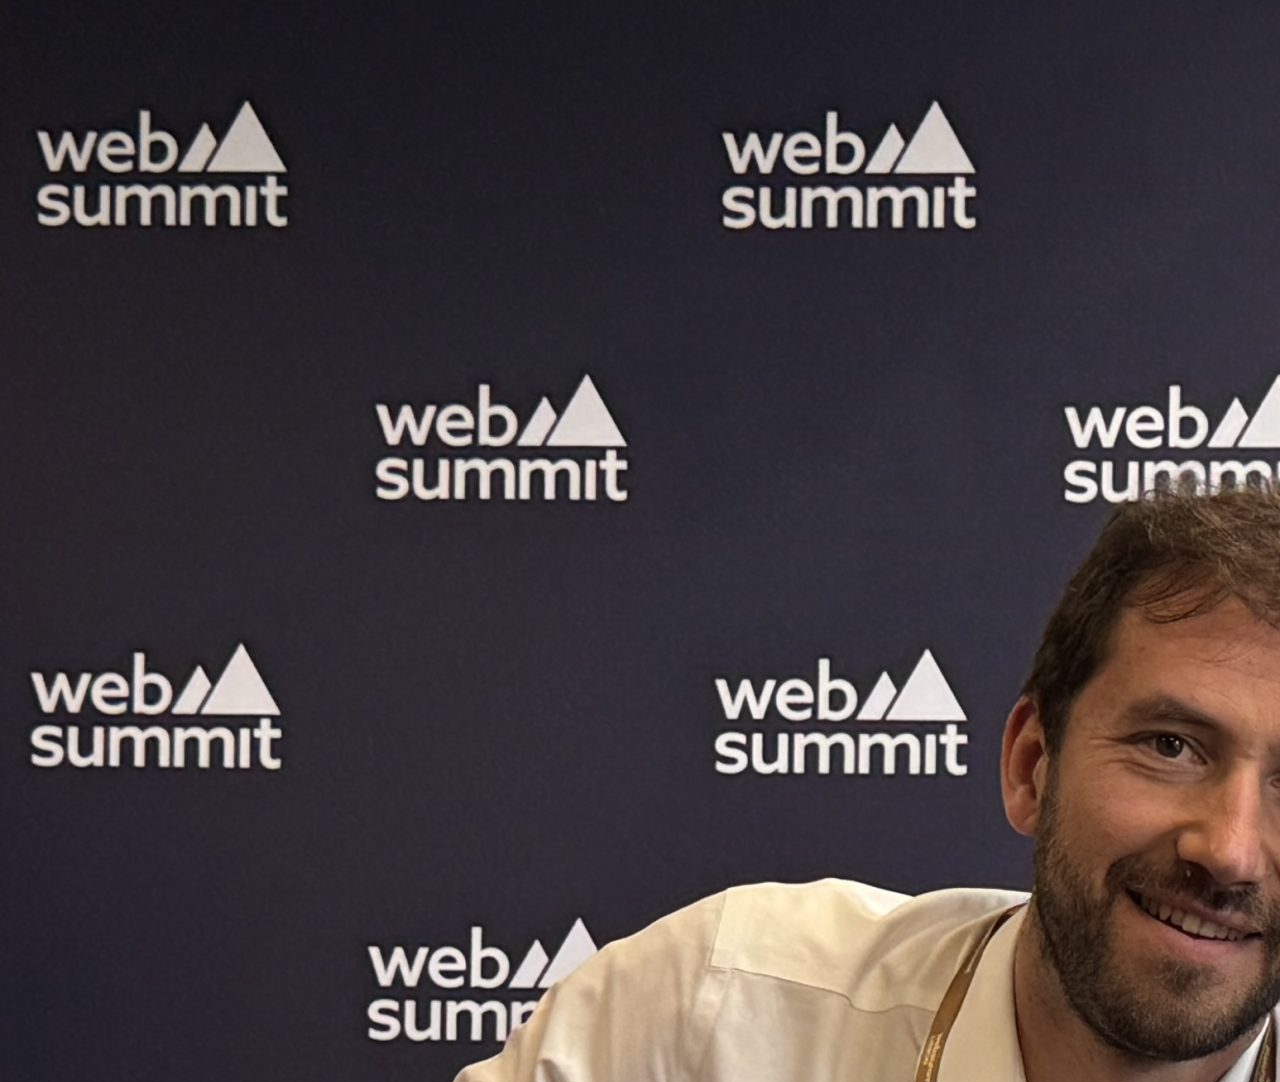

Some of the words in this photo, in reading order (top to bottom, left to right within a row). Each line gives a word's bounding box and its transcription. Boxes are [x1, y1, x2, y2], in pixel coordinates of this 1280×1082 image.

[38, 111, 178, 173] web
[723, 112, 865, 174] web
[38, 176, 288, 227] summit
[723, 177, 976, 228] summit
[376, 384, 517, 447] web
[1065, 386, 1208, 448] web
[376, 450, 627, 501] summit
[32, 653, 172, 714] web
[716, 659, 857, 721] web
[31, 718, 281, 769] summit
[715, 724, 967, 775] summit
[368, 927, 509, 989] web
